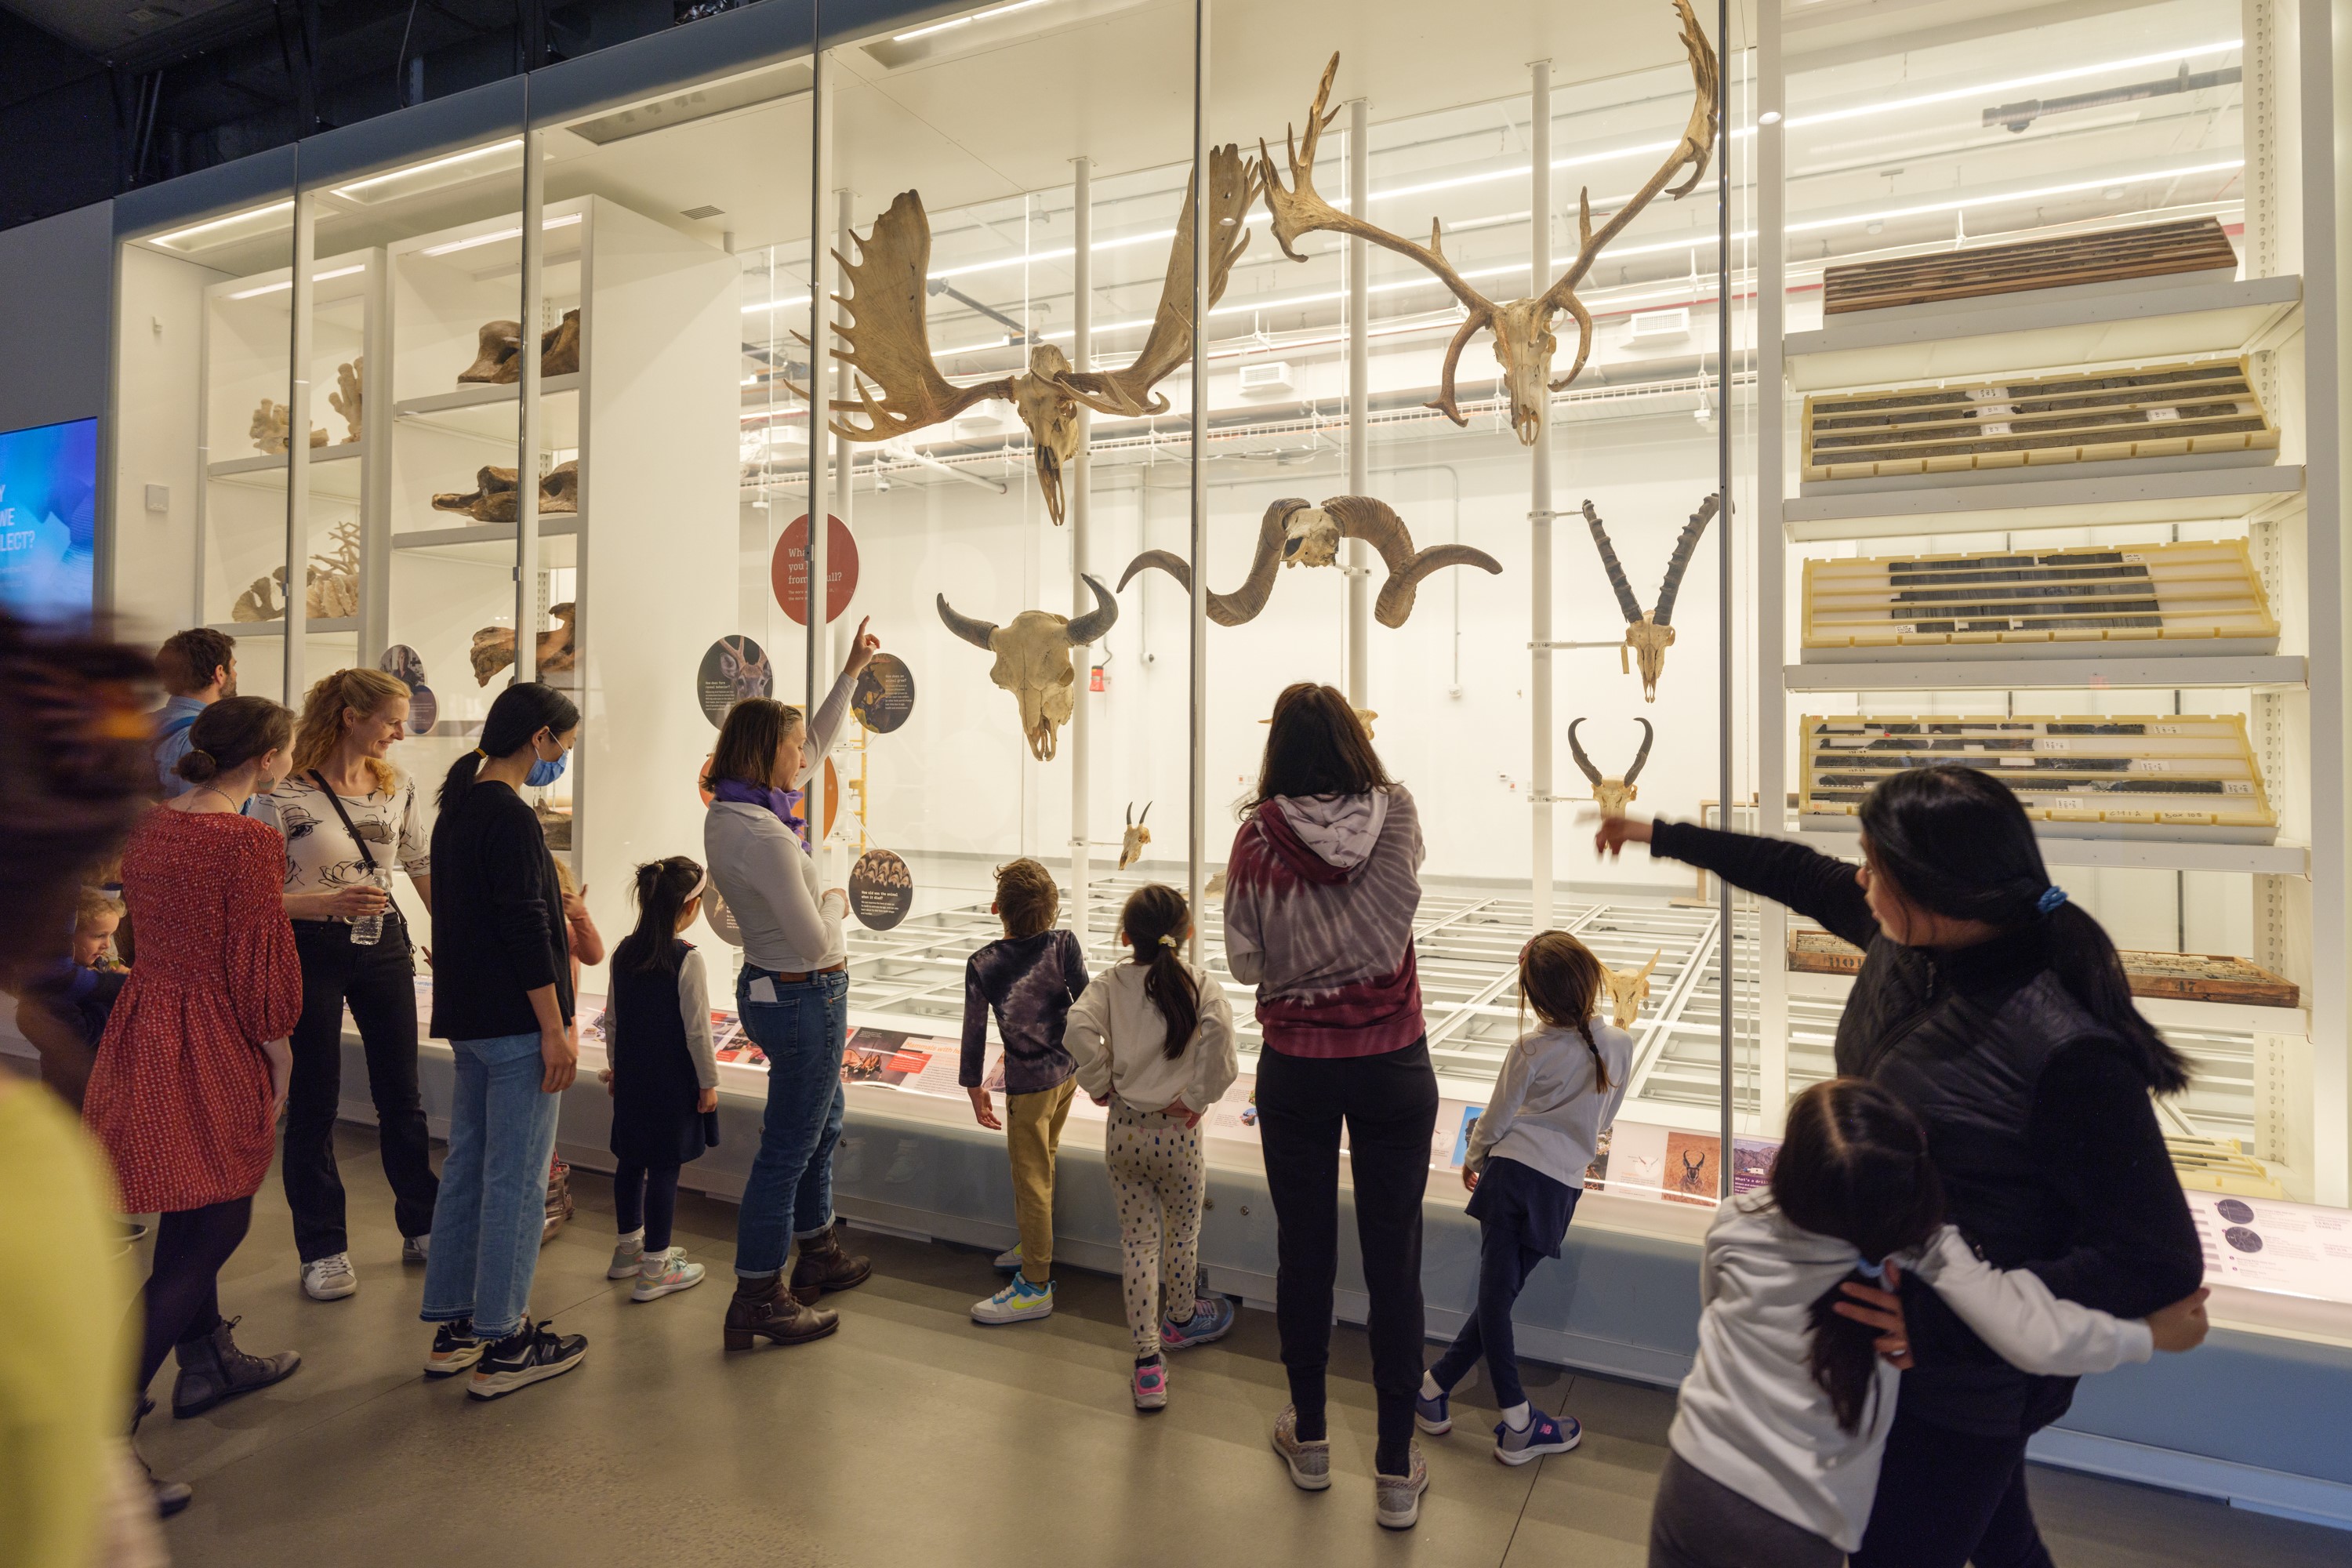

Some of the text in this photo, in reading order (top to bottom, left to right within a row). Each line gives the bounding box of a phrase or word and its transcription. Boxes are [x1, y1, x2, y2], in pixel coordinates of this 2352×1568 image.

[789, 564, 804, 572] you
[827, 572, 842, 582] ull?
[905, 1042, 937, 1051] Mammals
